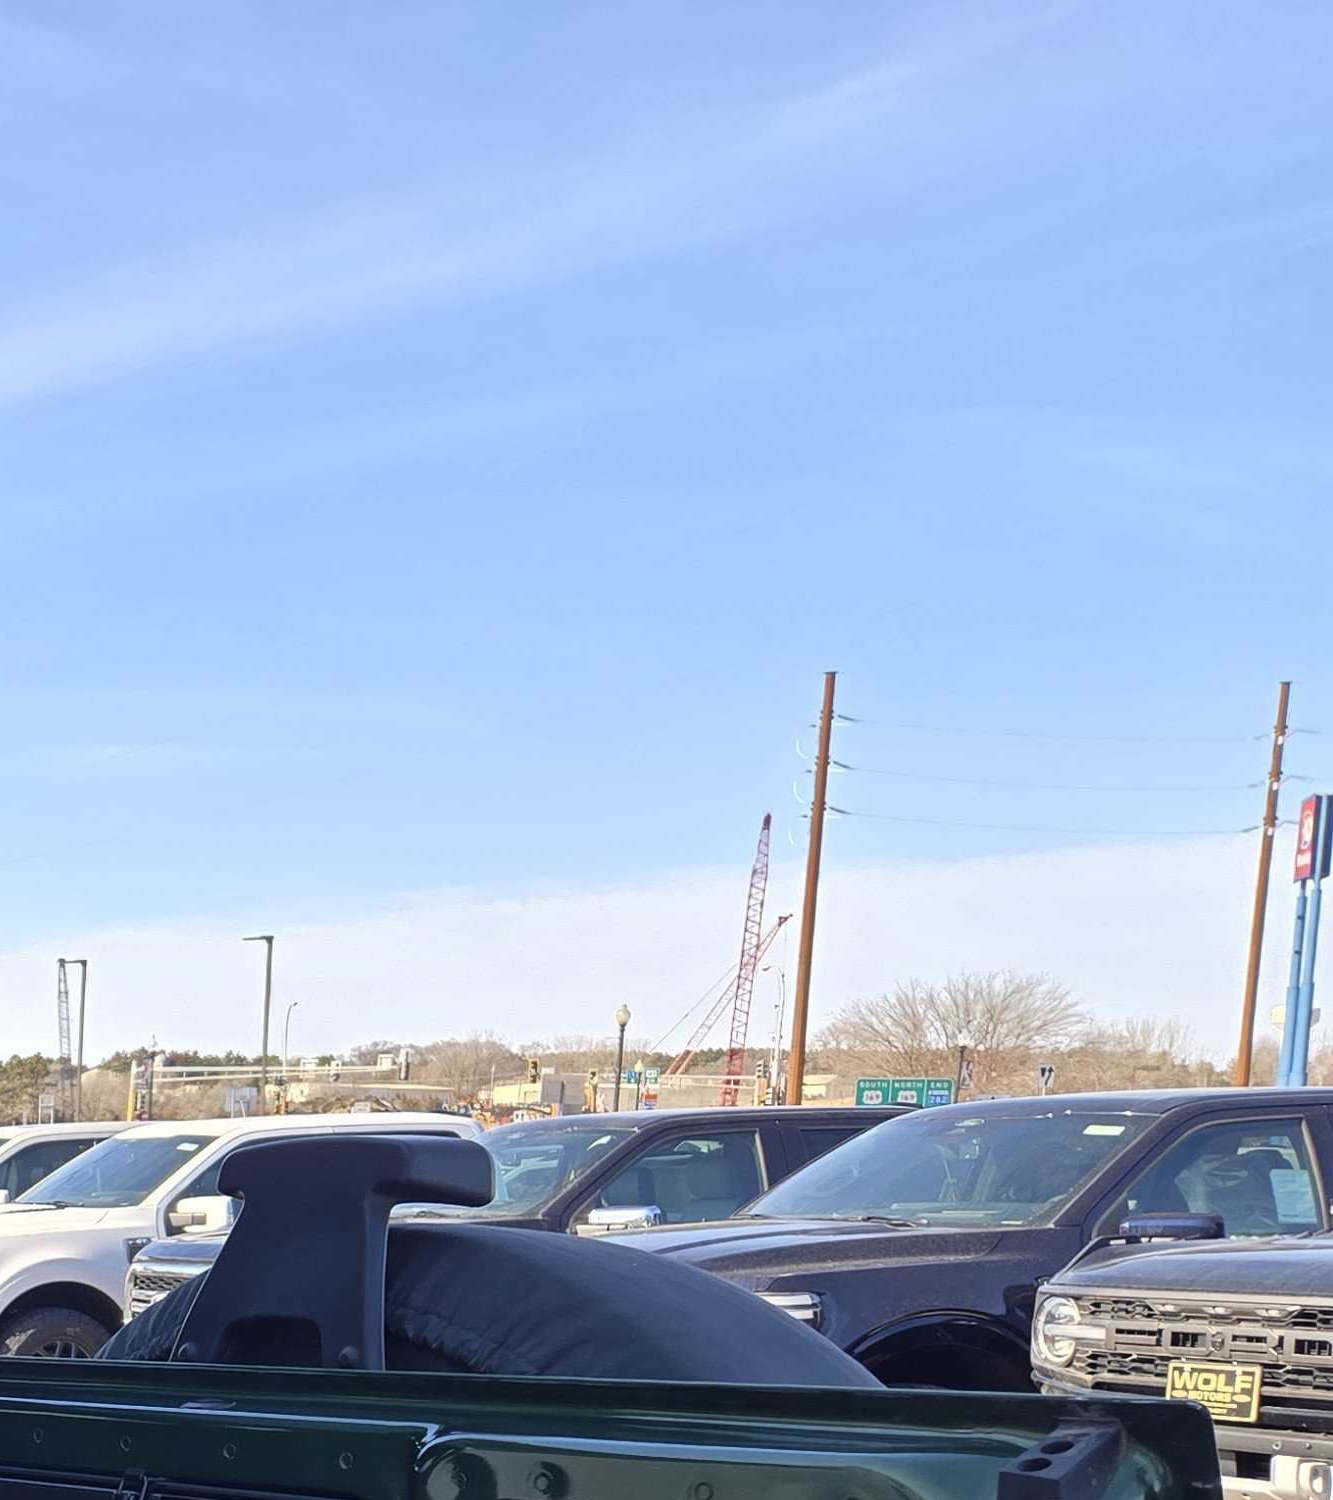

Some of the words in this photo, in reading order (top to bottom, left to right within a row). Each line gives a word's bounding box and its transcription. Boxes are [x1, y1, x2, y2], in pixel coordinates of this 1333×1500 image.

[865, 1093, 880, 1101] 169
[900, 1093, 915, 1101] 169
[1173, 1370, 1253, 1394] WOLF
[1187, 1390, 1232, 1403] MOTORS
